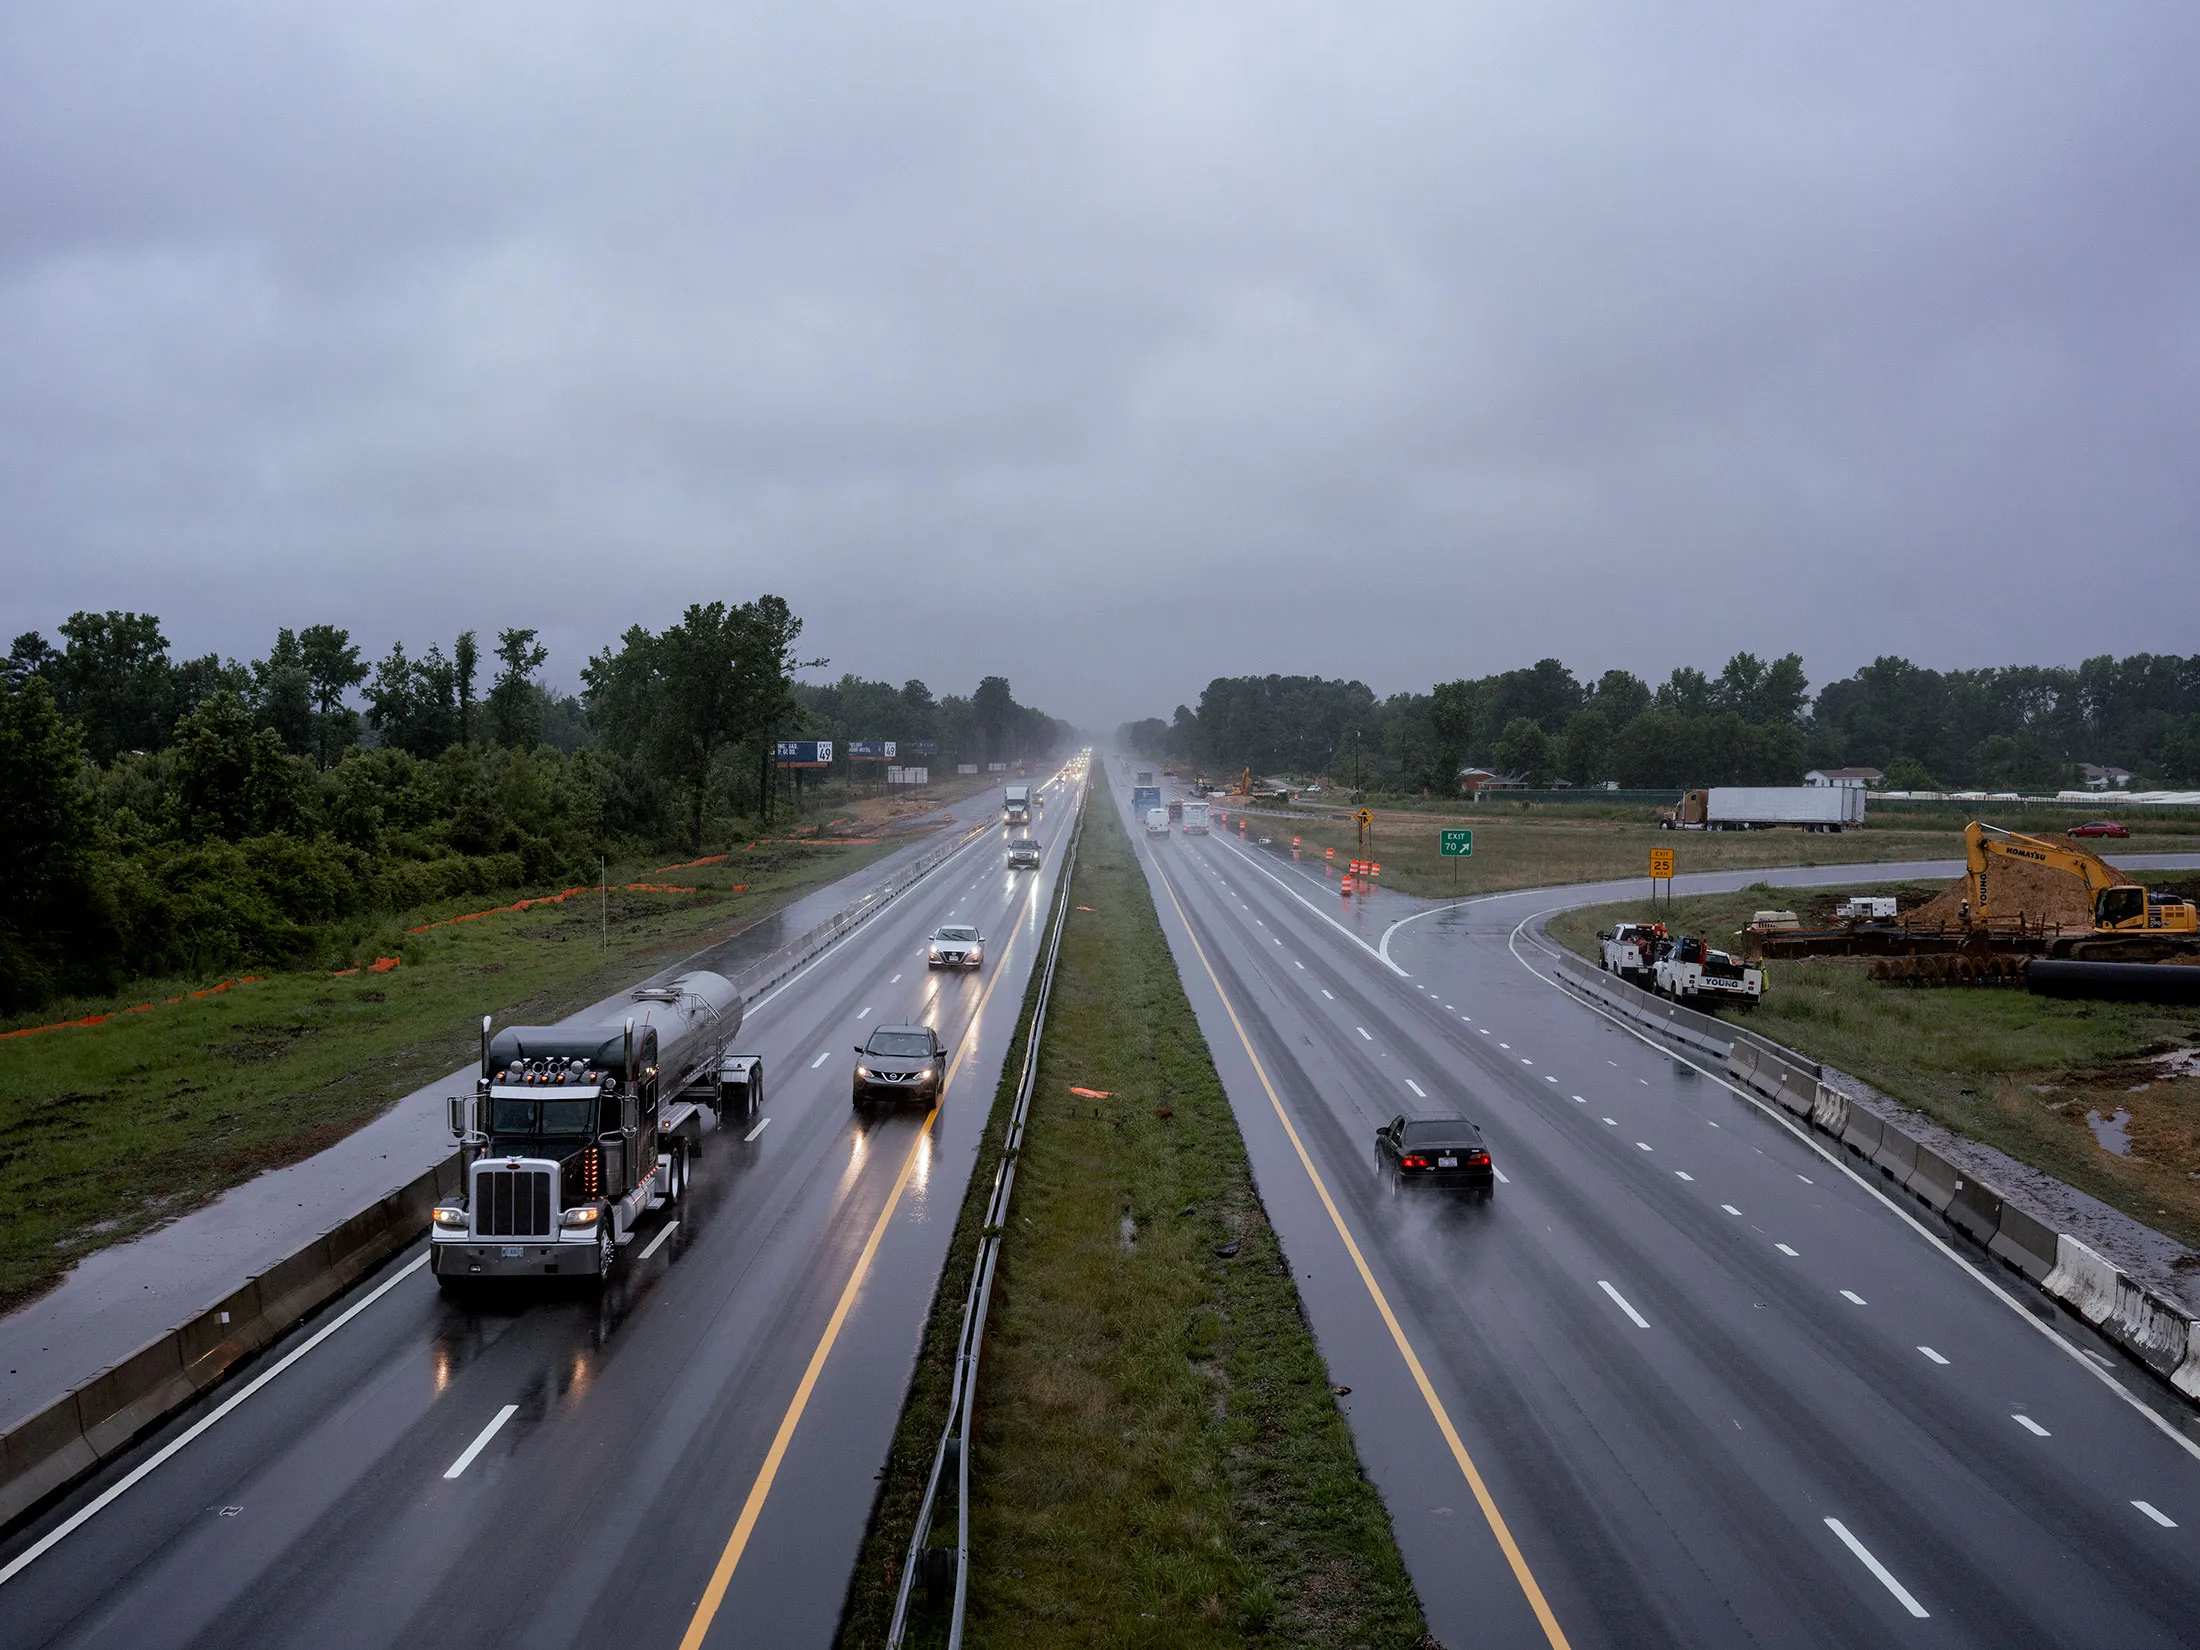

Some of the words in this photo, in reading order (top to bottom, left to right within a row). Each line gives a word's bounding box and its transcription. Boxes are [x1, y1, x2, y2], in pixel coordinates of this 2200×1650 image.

[819, 748, 831, 760] 49
[886, 746, 895, 756] 49
[1445, 842, 1457, 850] 70
[2006, 847, 2046, 861] KOMATSU
[1654, 861, 1669, 870] 25
[1706, 978, 1738, 988] YOUNG
